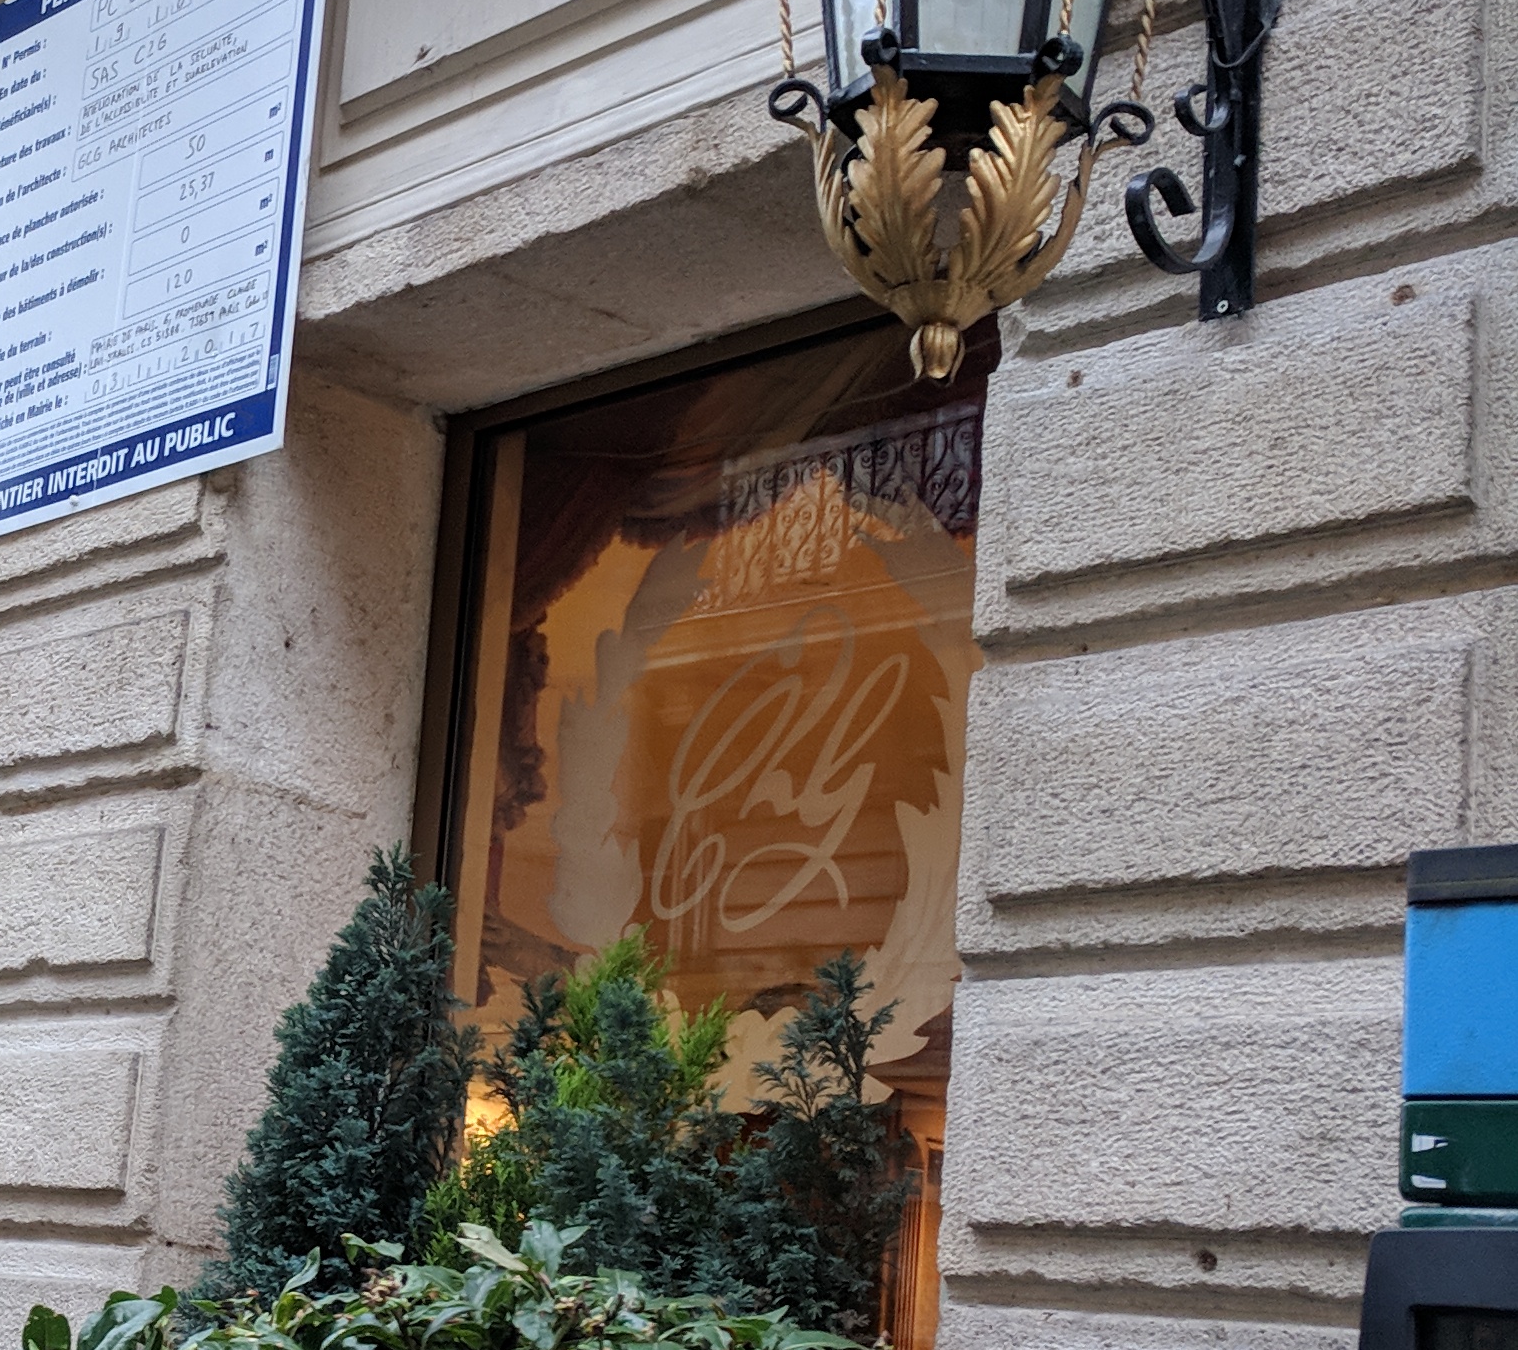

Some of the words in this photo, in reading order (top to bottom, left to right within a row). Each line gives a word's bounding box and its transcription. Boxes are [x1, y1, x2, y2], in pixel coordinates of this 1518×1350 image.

[9, 77, 29, 96] date
[29, 69, 42, 85] du
[18, 143, 34, 160] des
[34, 127, 67, 153] travaux
[184, 133, 207, 161] 50
[179, 170, 216, 202] 25,37
[11, 225, 23, 241] de
[22, 209, 60, 239] plancher
[59, 189, 99, 219] autorisée
[2, 306, 17, 322] des
[17, 287, 58, 315] bâtiments
[58, 281, 65, 298] à
[66, 268, 100, 294] démolir
[6, 343, 19, 359] du
[19, 331, 47, 354] terrain
[3, 370, 23, 393] peut
[23, 366, 41, 383] être
[41, 348, 77, 376] consulté
[46, 447, 130, 496] INTERDIT
[129, 436, 161, 469] AU
[163, 411, 236, 457] PUBLIC
